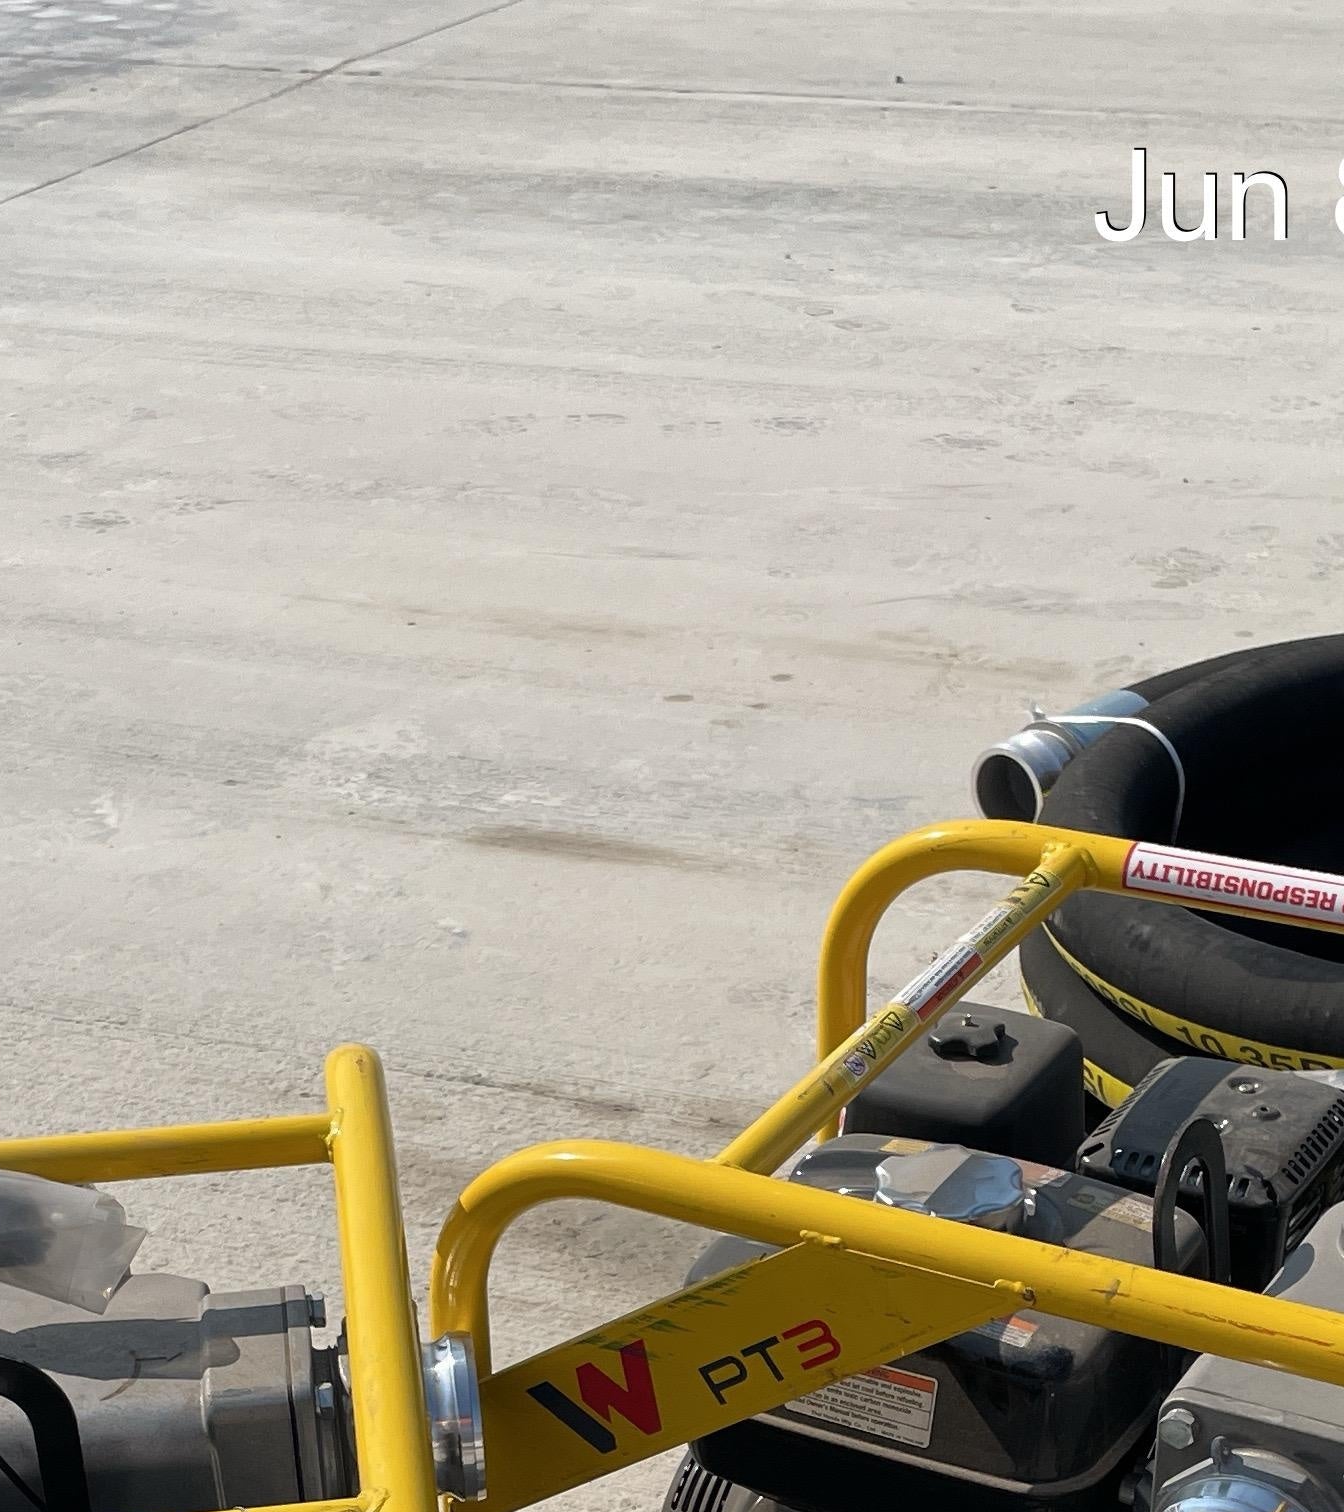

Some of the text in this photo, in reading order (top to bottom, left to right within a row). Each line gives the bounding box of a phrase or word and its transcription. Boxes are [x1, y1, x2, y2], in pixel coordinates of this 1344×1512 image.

[1130, 859, 1337, 912] RESPONSIBILITY
[698, 1318, 842, 1406] PT3
[874, 1389, 895, 1399] before
[859, 1395, 881, 1406] carbon
[829, 1405, 850, 1416] Manual
